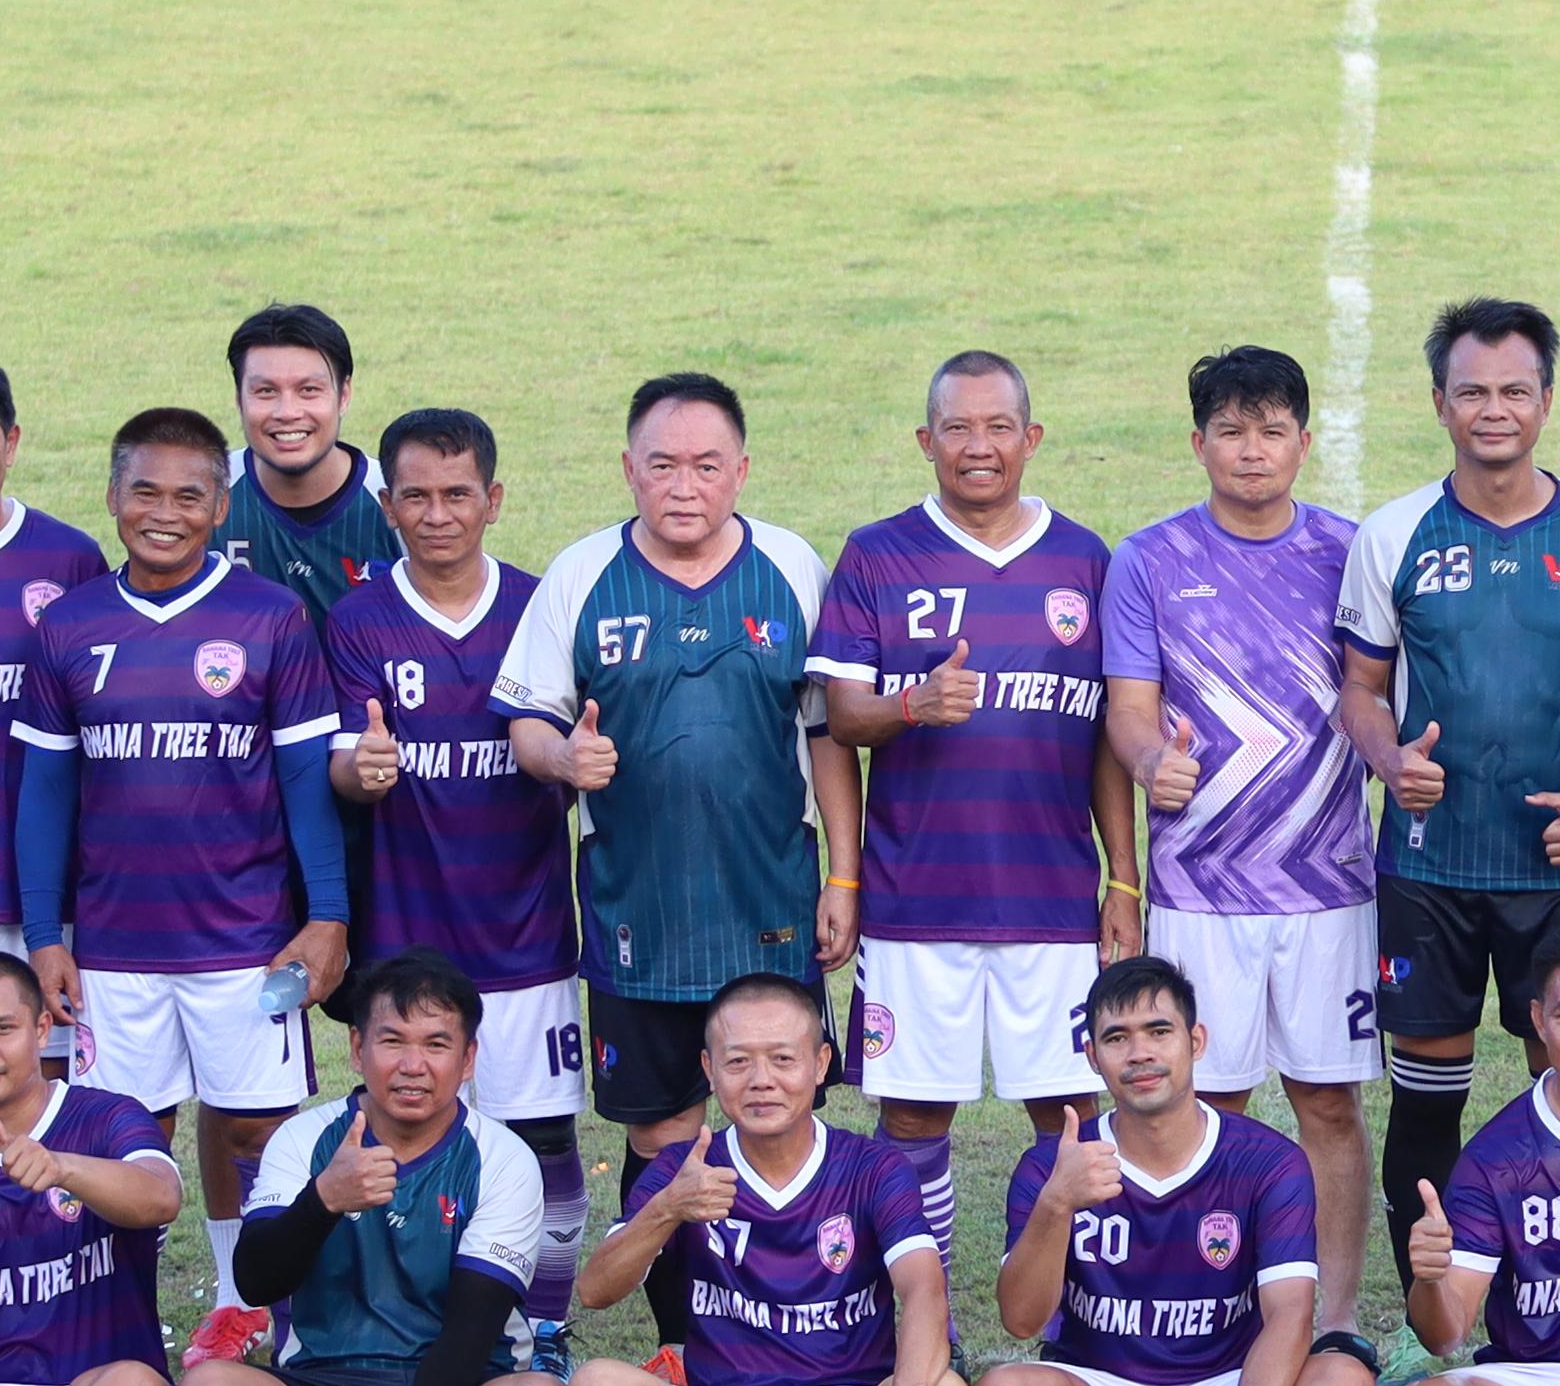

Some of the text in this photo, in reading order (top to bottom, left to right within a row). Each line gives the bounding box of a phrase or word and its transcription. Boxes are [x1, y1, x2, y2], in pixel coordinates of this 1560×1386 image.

[1414, 543, 1474, 597] 23
[596, 612, 652, 667] 57
[906, 587, 968, 640] 27
[89, 643, 119, 695] 7
[995, 671, 1058, 713] TREE
[1061, 675, 1105, 722] TAK
[150, 721, 213, 762] TREE
[217, 722, 259, 762] TAK
[545, 1021, 584, 1078] 18
[1068, 1002, 1093, 1054] 2
[1073, 1208, 1131, 1266] 20
[691, 1278, 773, 1331] BANANA
[780, 1298, 839, 1335] TREE
[1150, 1298, 1215, 1338] TREE
